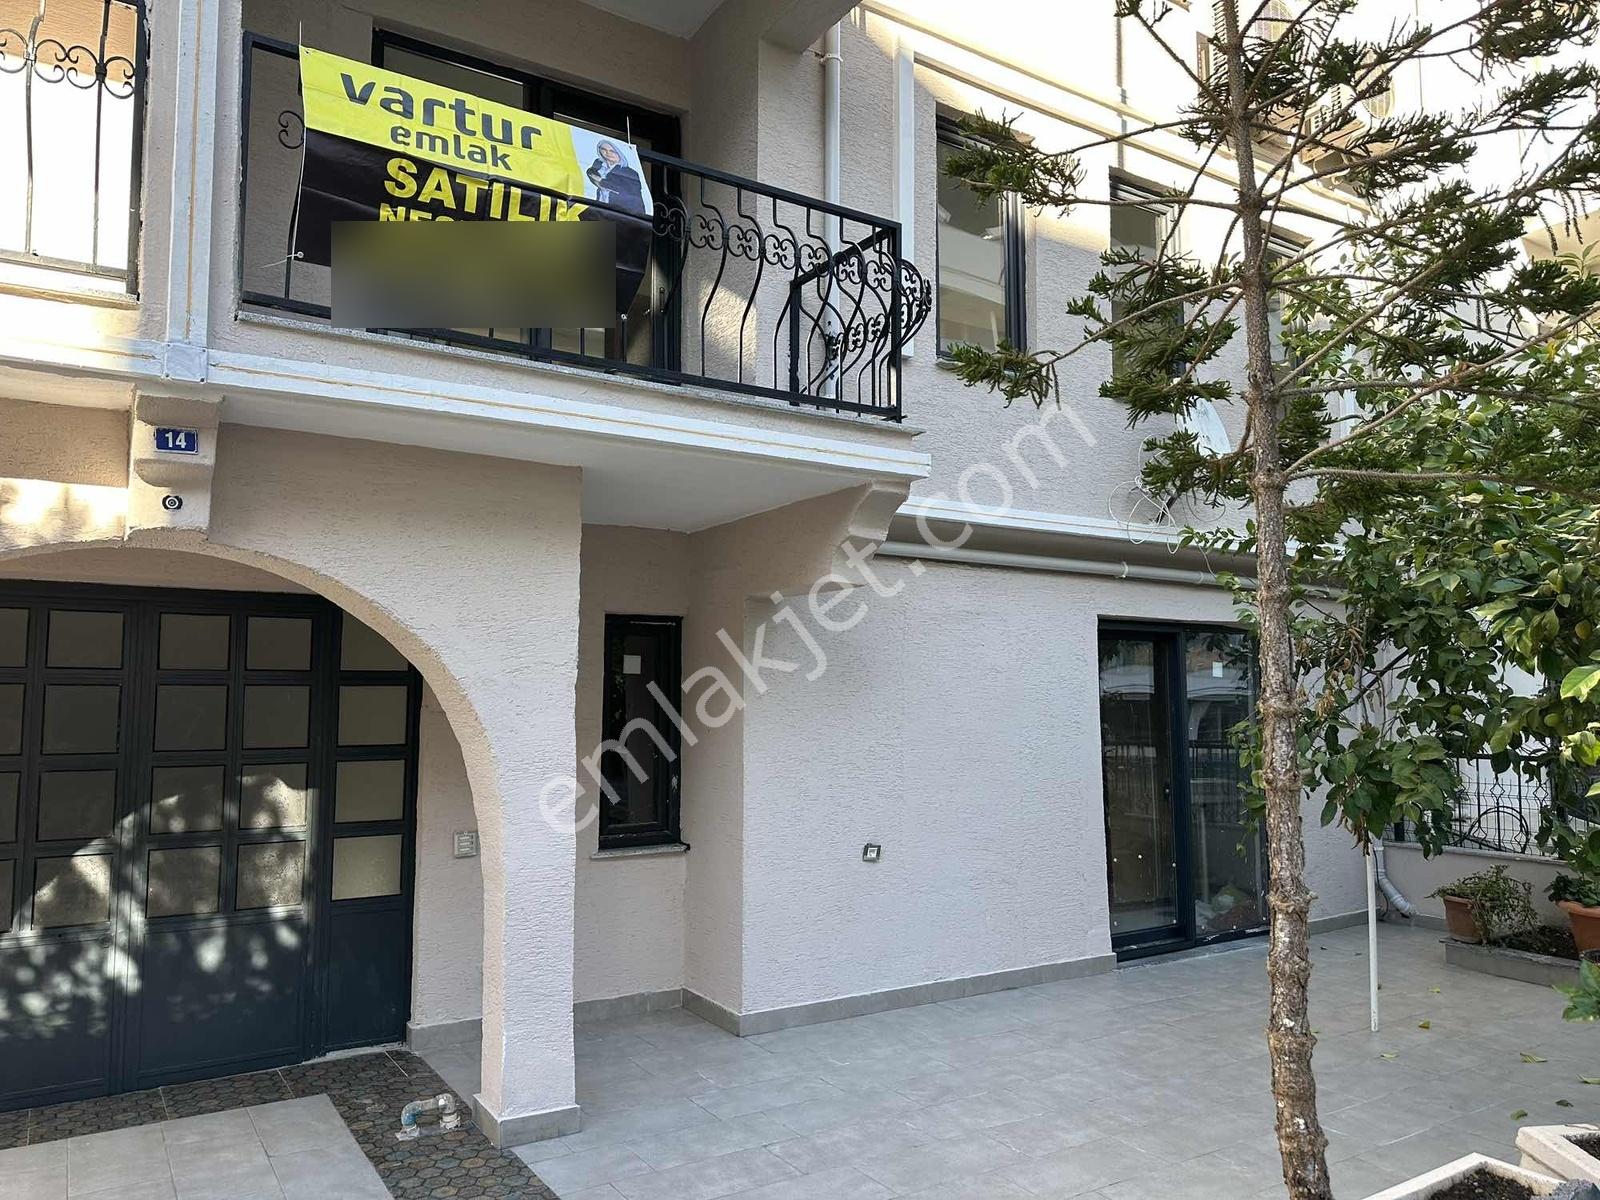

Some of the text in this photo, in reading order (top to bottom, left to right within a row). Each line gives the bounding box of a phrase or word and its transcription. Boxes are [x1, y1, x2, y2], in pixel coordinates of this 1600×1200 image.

[341, 73, 542, 150] vartur
[390, 125, 512, 171] emlak
[384, 157, 589, 221] SATILIK
[165, 431, 187, 449] 14
